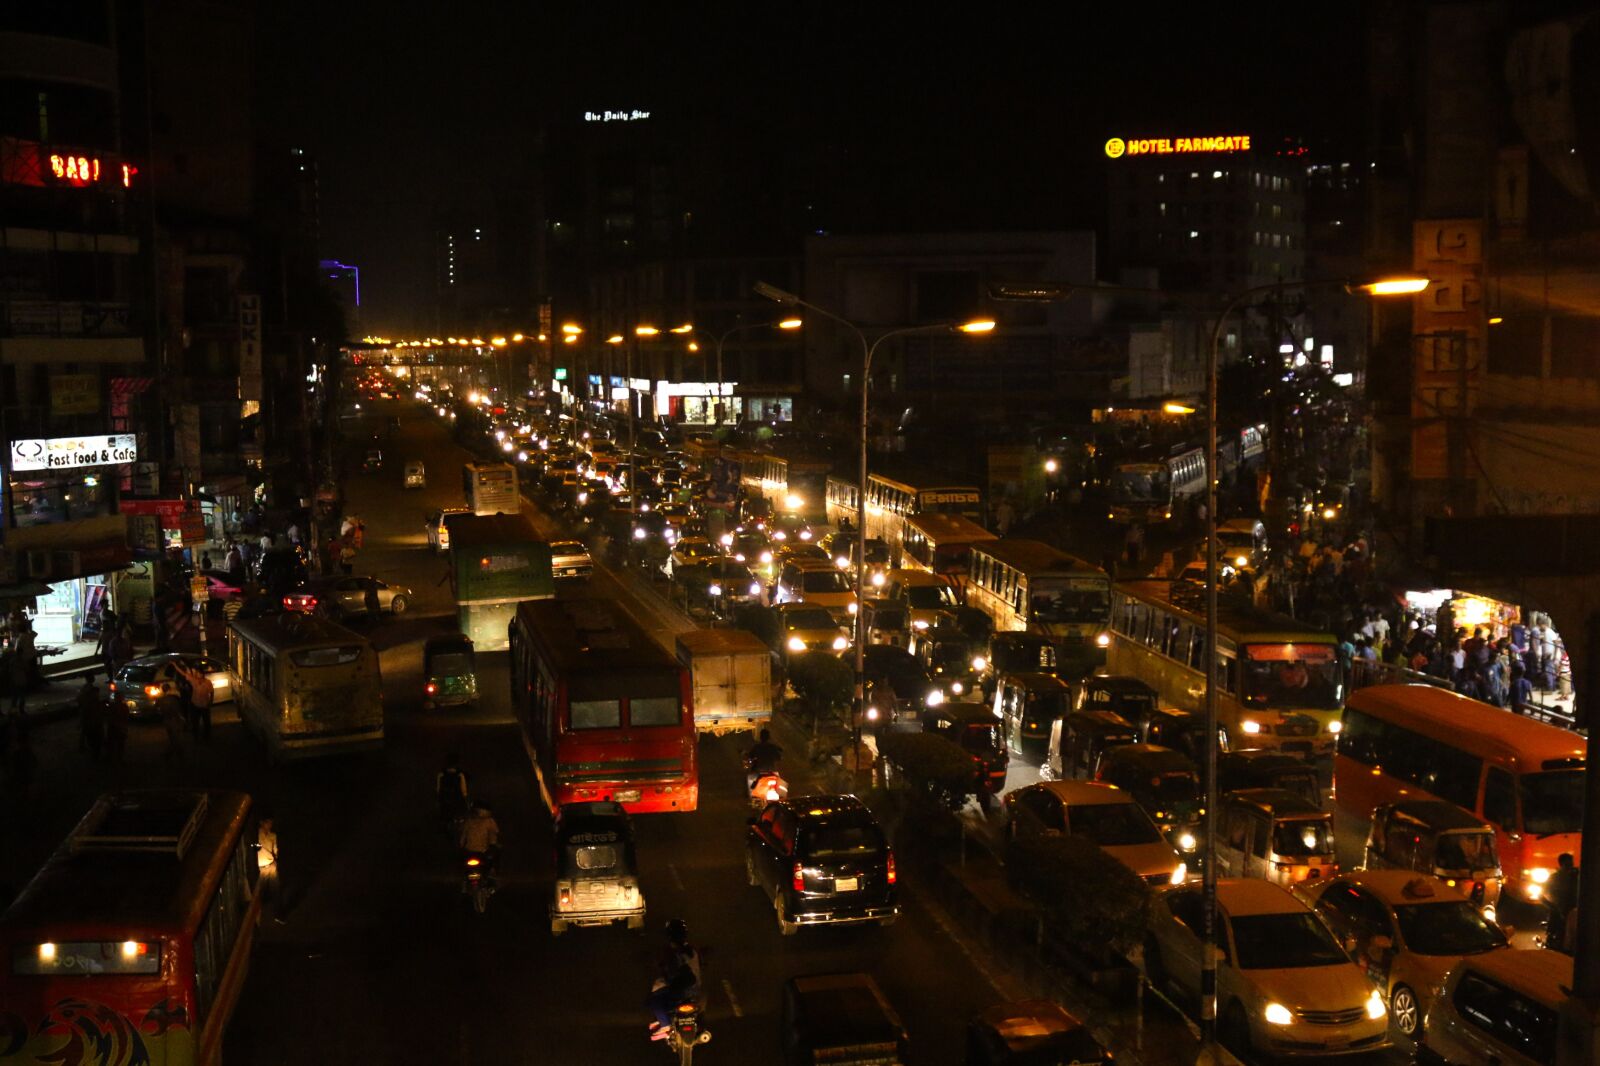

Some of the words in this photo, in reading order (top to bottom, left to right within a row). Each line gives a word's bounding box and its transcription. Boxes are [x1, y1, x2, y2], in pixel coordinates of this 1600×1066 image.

[584, 111, 602, 121] The
[603, 110, 629, 122] Daily
[630, 109, 651, 121] Star
[1127, 138, 1174, 154] HOTEL
[1175, 136, 1251, 152] FARMGATE
[48, 453, 71, 467] Fast
[74, 450, 98, 464] food
[101, 449, 110, 462] &
[113, 448, 136, 461] Cafe
